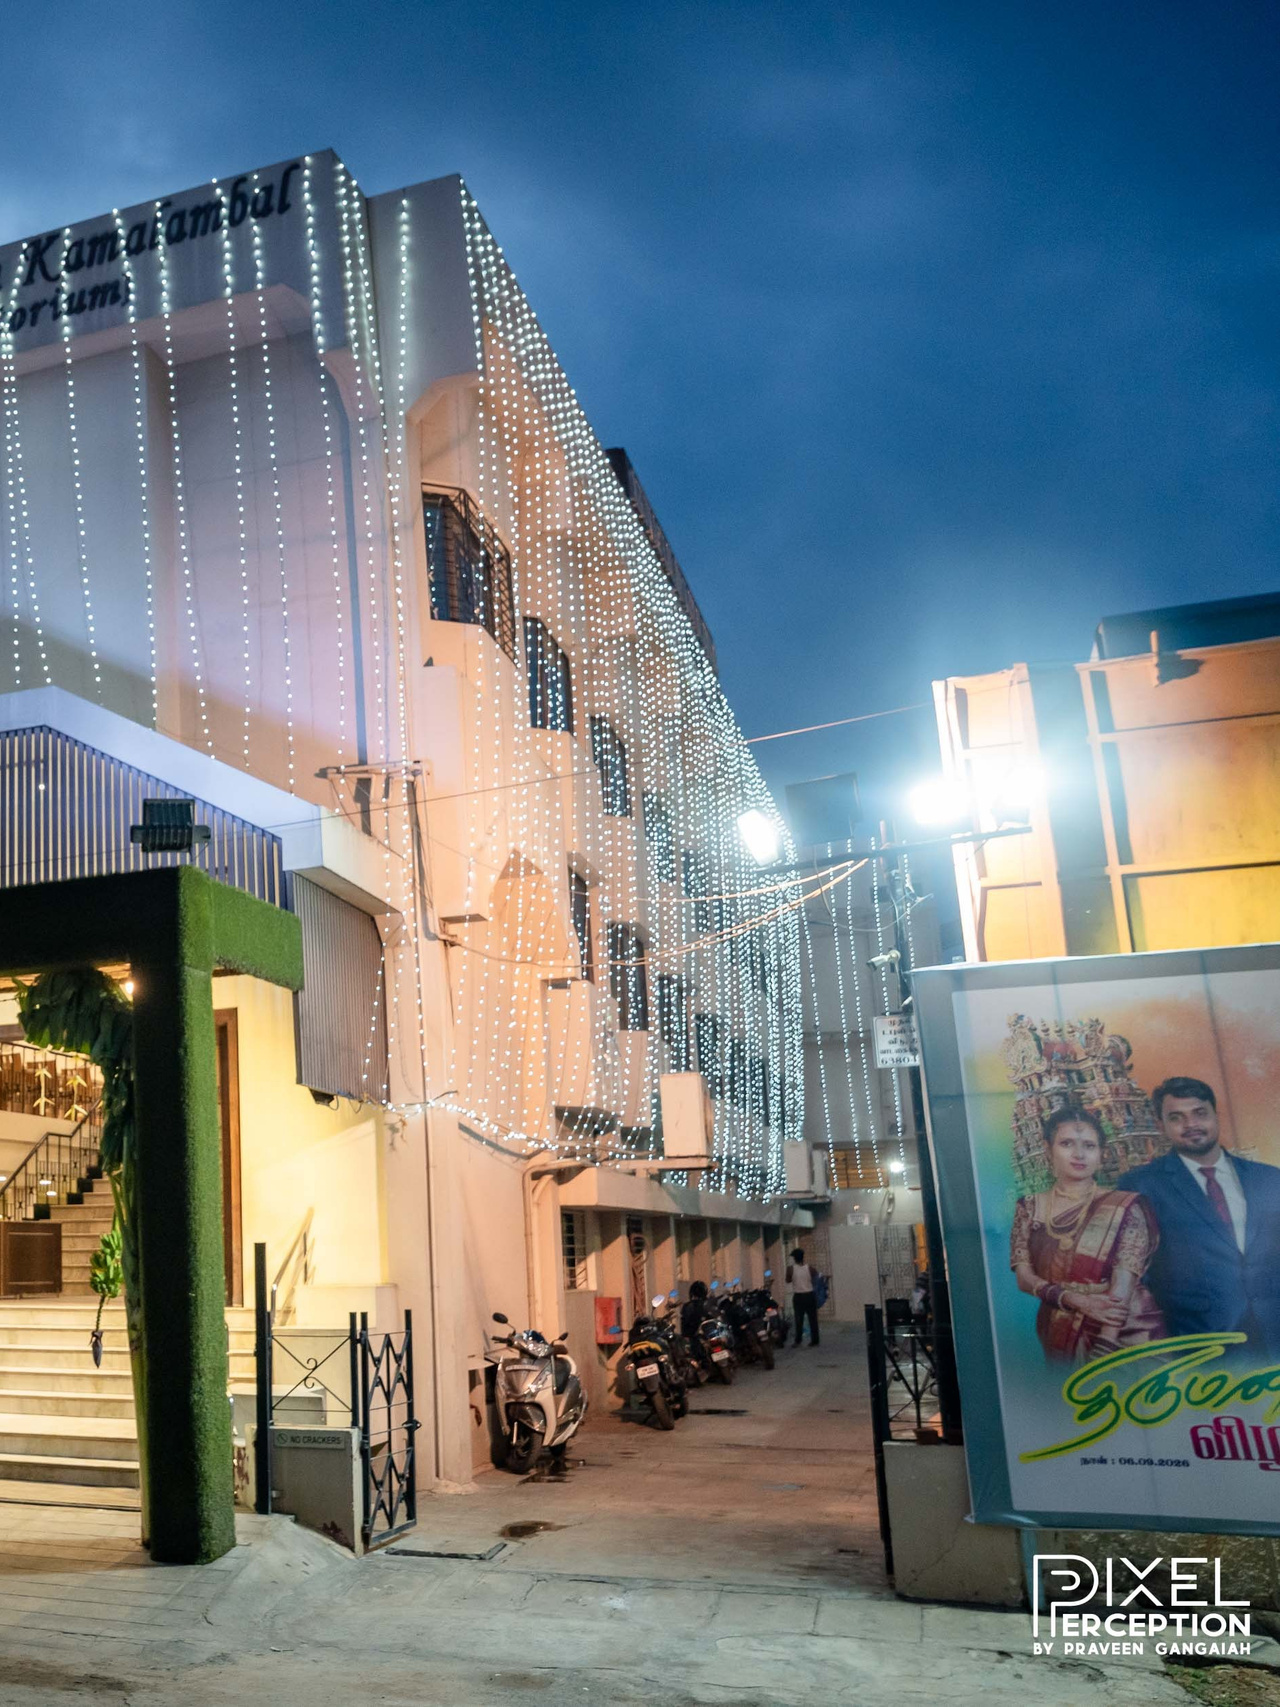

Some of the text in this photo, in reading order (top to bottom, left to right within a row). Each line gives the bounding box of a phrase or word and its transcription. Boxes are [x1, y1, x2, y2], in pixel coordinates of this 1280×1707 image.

[23, 161, 300, 286] Kamalambal
[290, 1435, 341, 1445] NO CRACKERS
[1118, 1457, 1191, 1468] 06.09.2026
